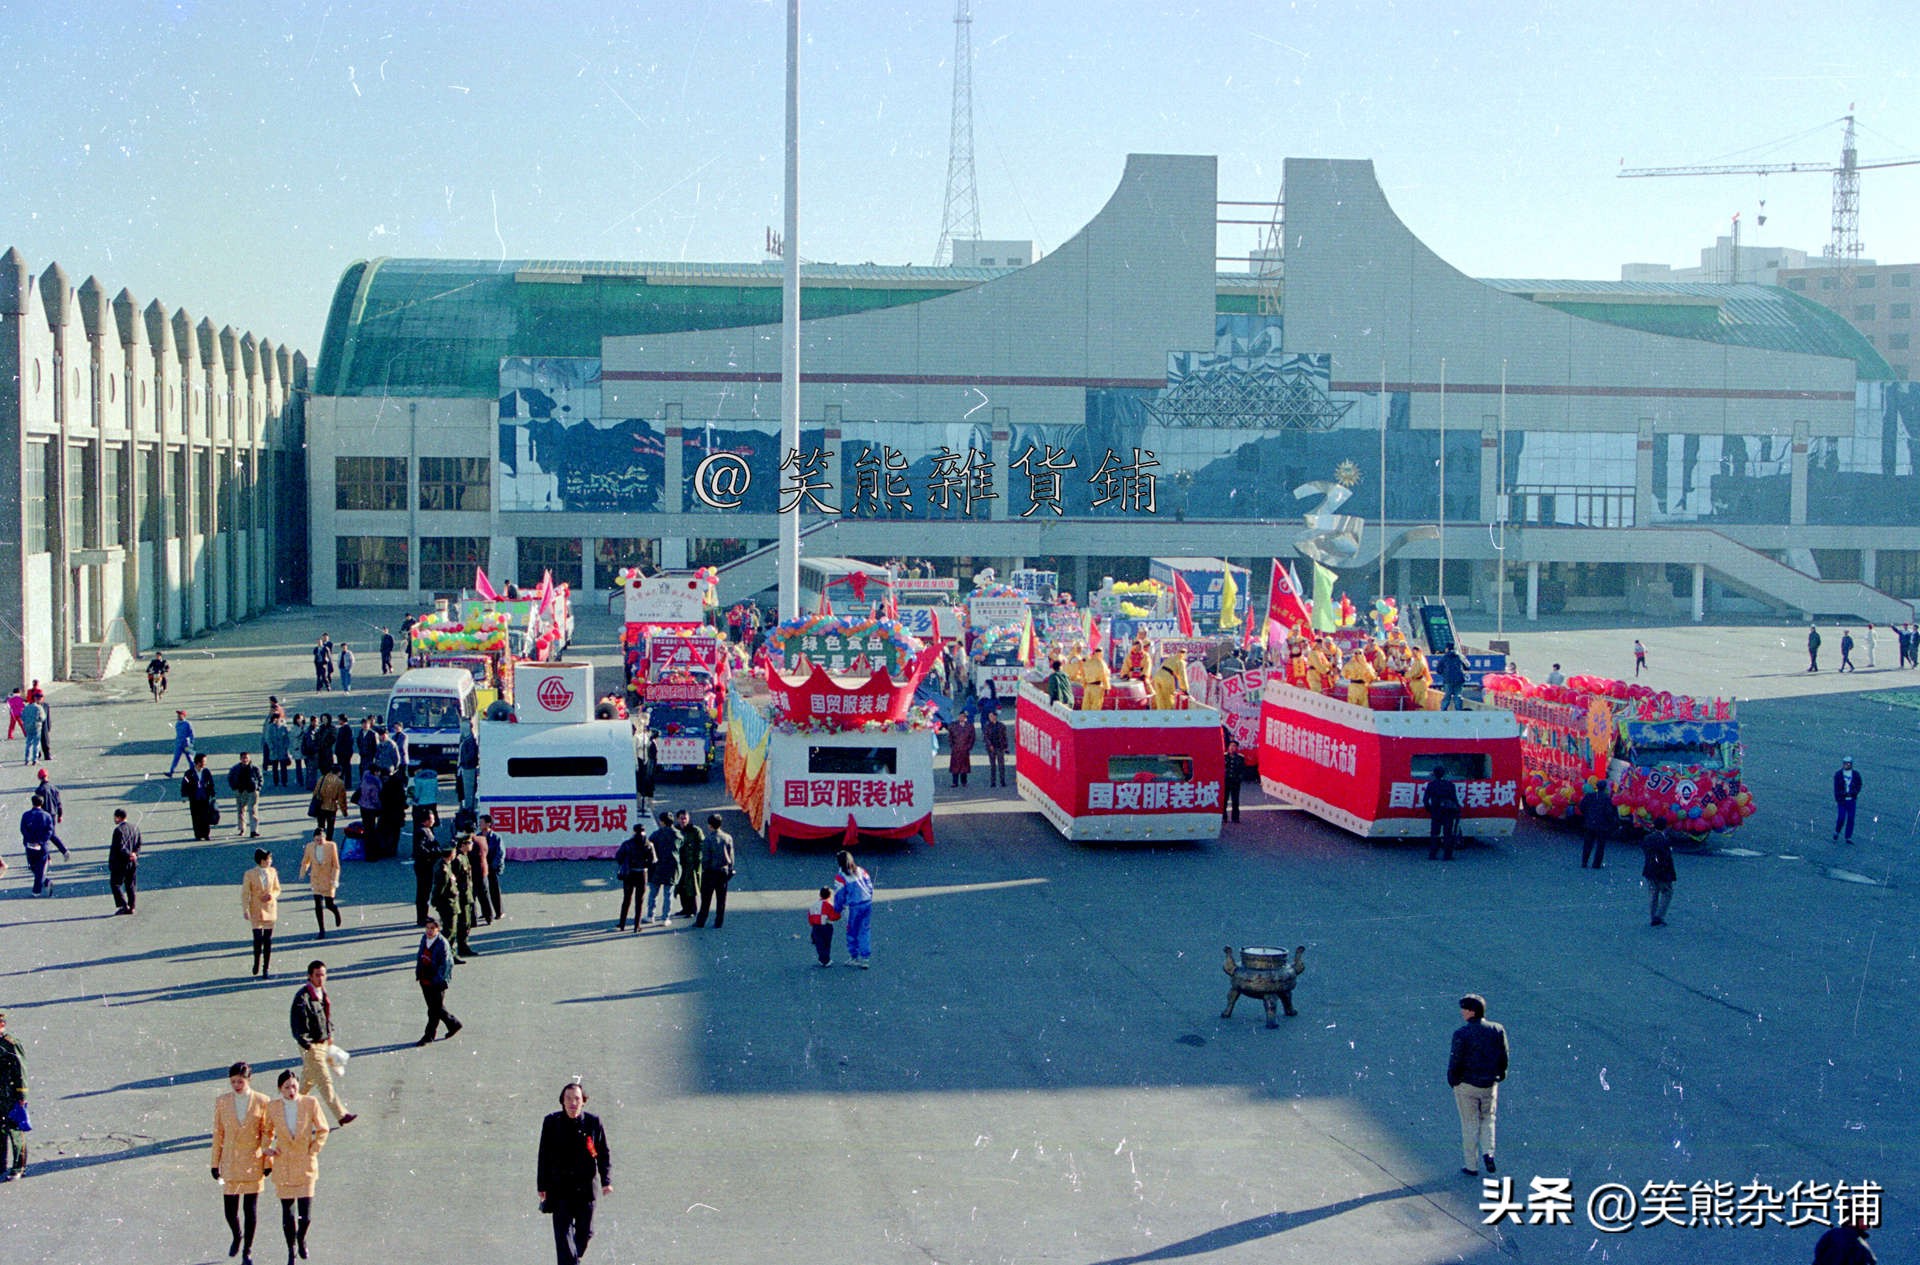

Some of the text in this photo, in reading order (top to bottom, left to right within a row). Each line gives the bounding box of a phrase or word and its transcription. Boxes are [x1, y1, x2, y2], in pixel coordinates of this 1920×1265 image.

[801, 635, 883, 651] 绿色食品
[810, 693, 890, 715] 国贸服装城
[784, 779, 914, 808] 国贸服装城
[1088, 781, 1220, 809] 国贸服装城
[1647, 772, 1674, 793] 97
[489, 804, 627, 834] 国际贸易城
